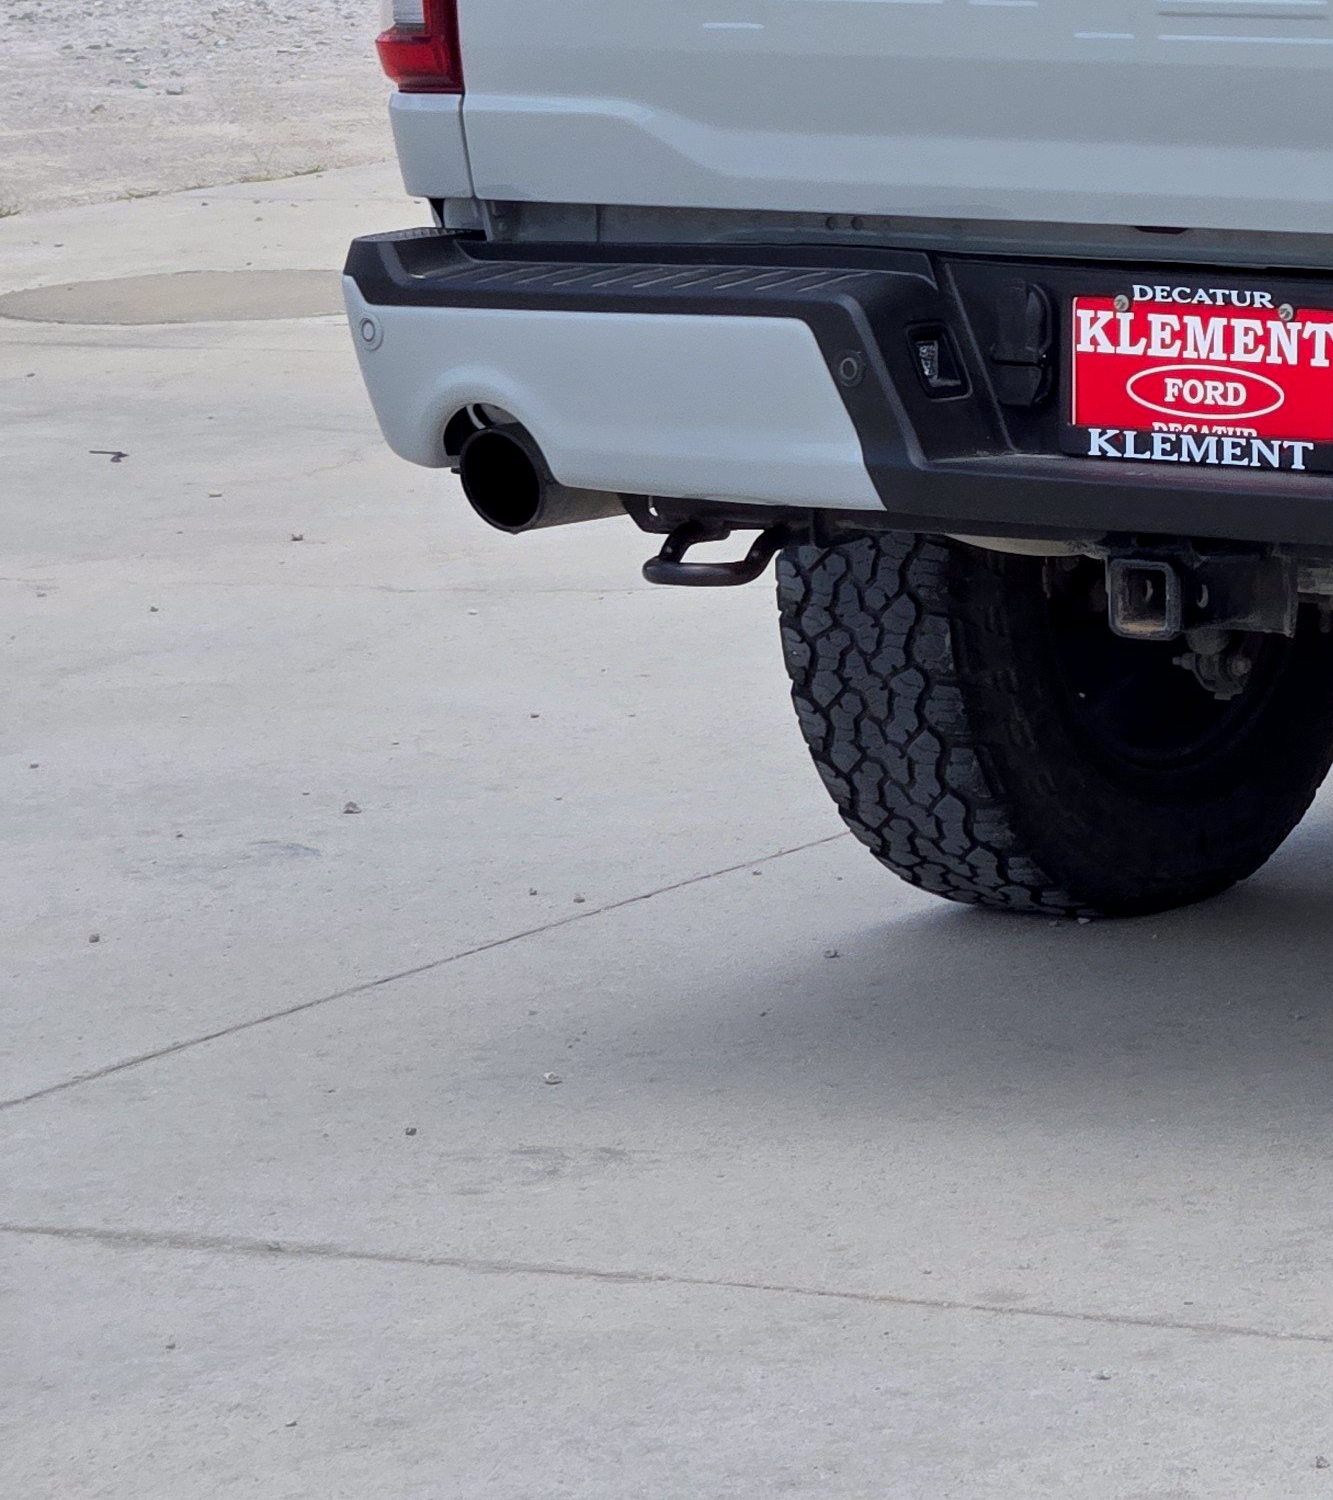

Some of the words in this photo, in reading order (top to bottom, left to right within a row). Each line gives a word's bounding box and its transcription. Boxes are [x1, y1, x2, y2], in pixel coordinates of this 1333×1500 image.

[1132, 285, 1275, 309] DECATUR
[1164, 378, 1248, 407] FORD
[1088, 428, 1314, 470] KLEMENT
